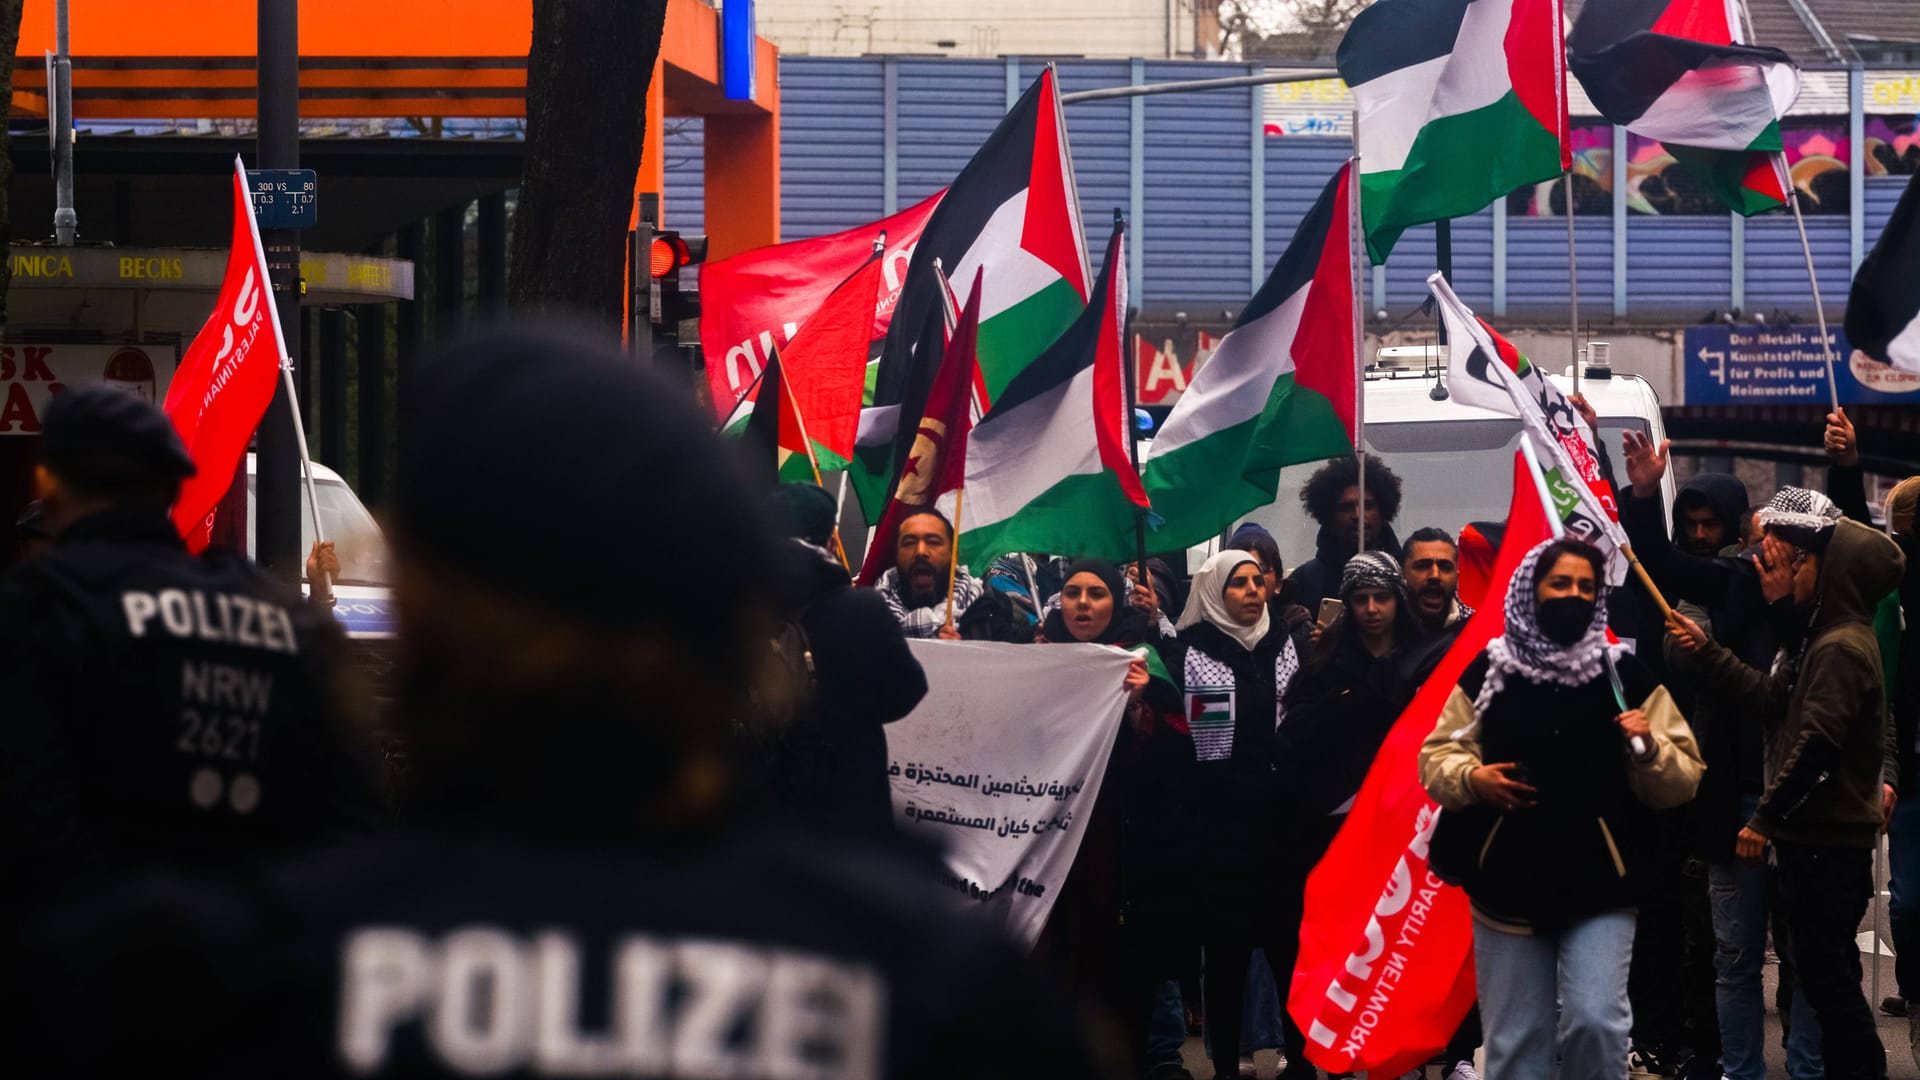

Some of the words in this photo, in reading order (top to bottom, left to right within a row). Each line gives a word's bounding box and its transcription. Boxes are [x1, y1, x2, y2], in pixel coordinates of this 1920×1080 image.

[258, 182, 273, 191] 300
[276, 182, 287, 191] VS
[303, 182, 314, 191] 80
[261, 195, 274, 204] 0.3
[301, 195, 314, 204] 0.7
[291, 205, 304, 214] 2.1
[119, 257, 183, 279] BECKS
[1730, 333, 1753, 346] Der
[1758, 332, 1807, 345] Metall-
[1754, 367, 1795, 379] Profis
[1799, 367, 1825, 379] und
[1730, 384, 1816, 396] Heimwerker!
[122, 589, 297, 653] POLIZEI
[182, 663, 272, 713] NRW
[178, 710, 260, 759] 2621
[905, 800, 996, 831] المستعمرة
[997, 817, 1030, 838] كيان
[338, 926, 884, 1078] POLIZEI
